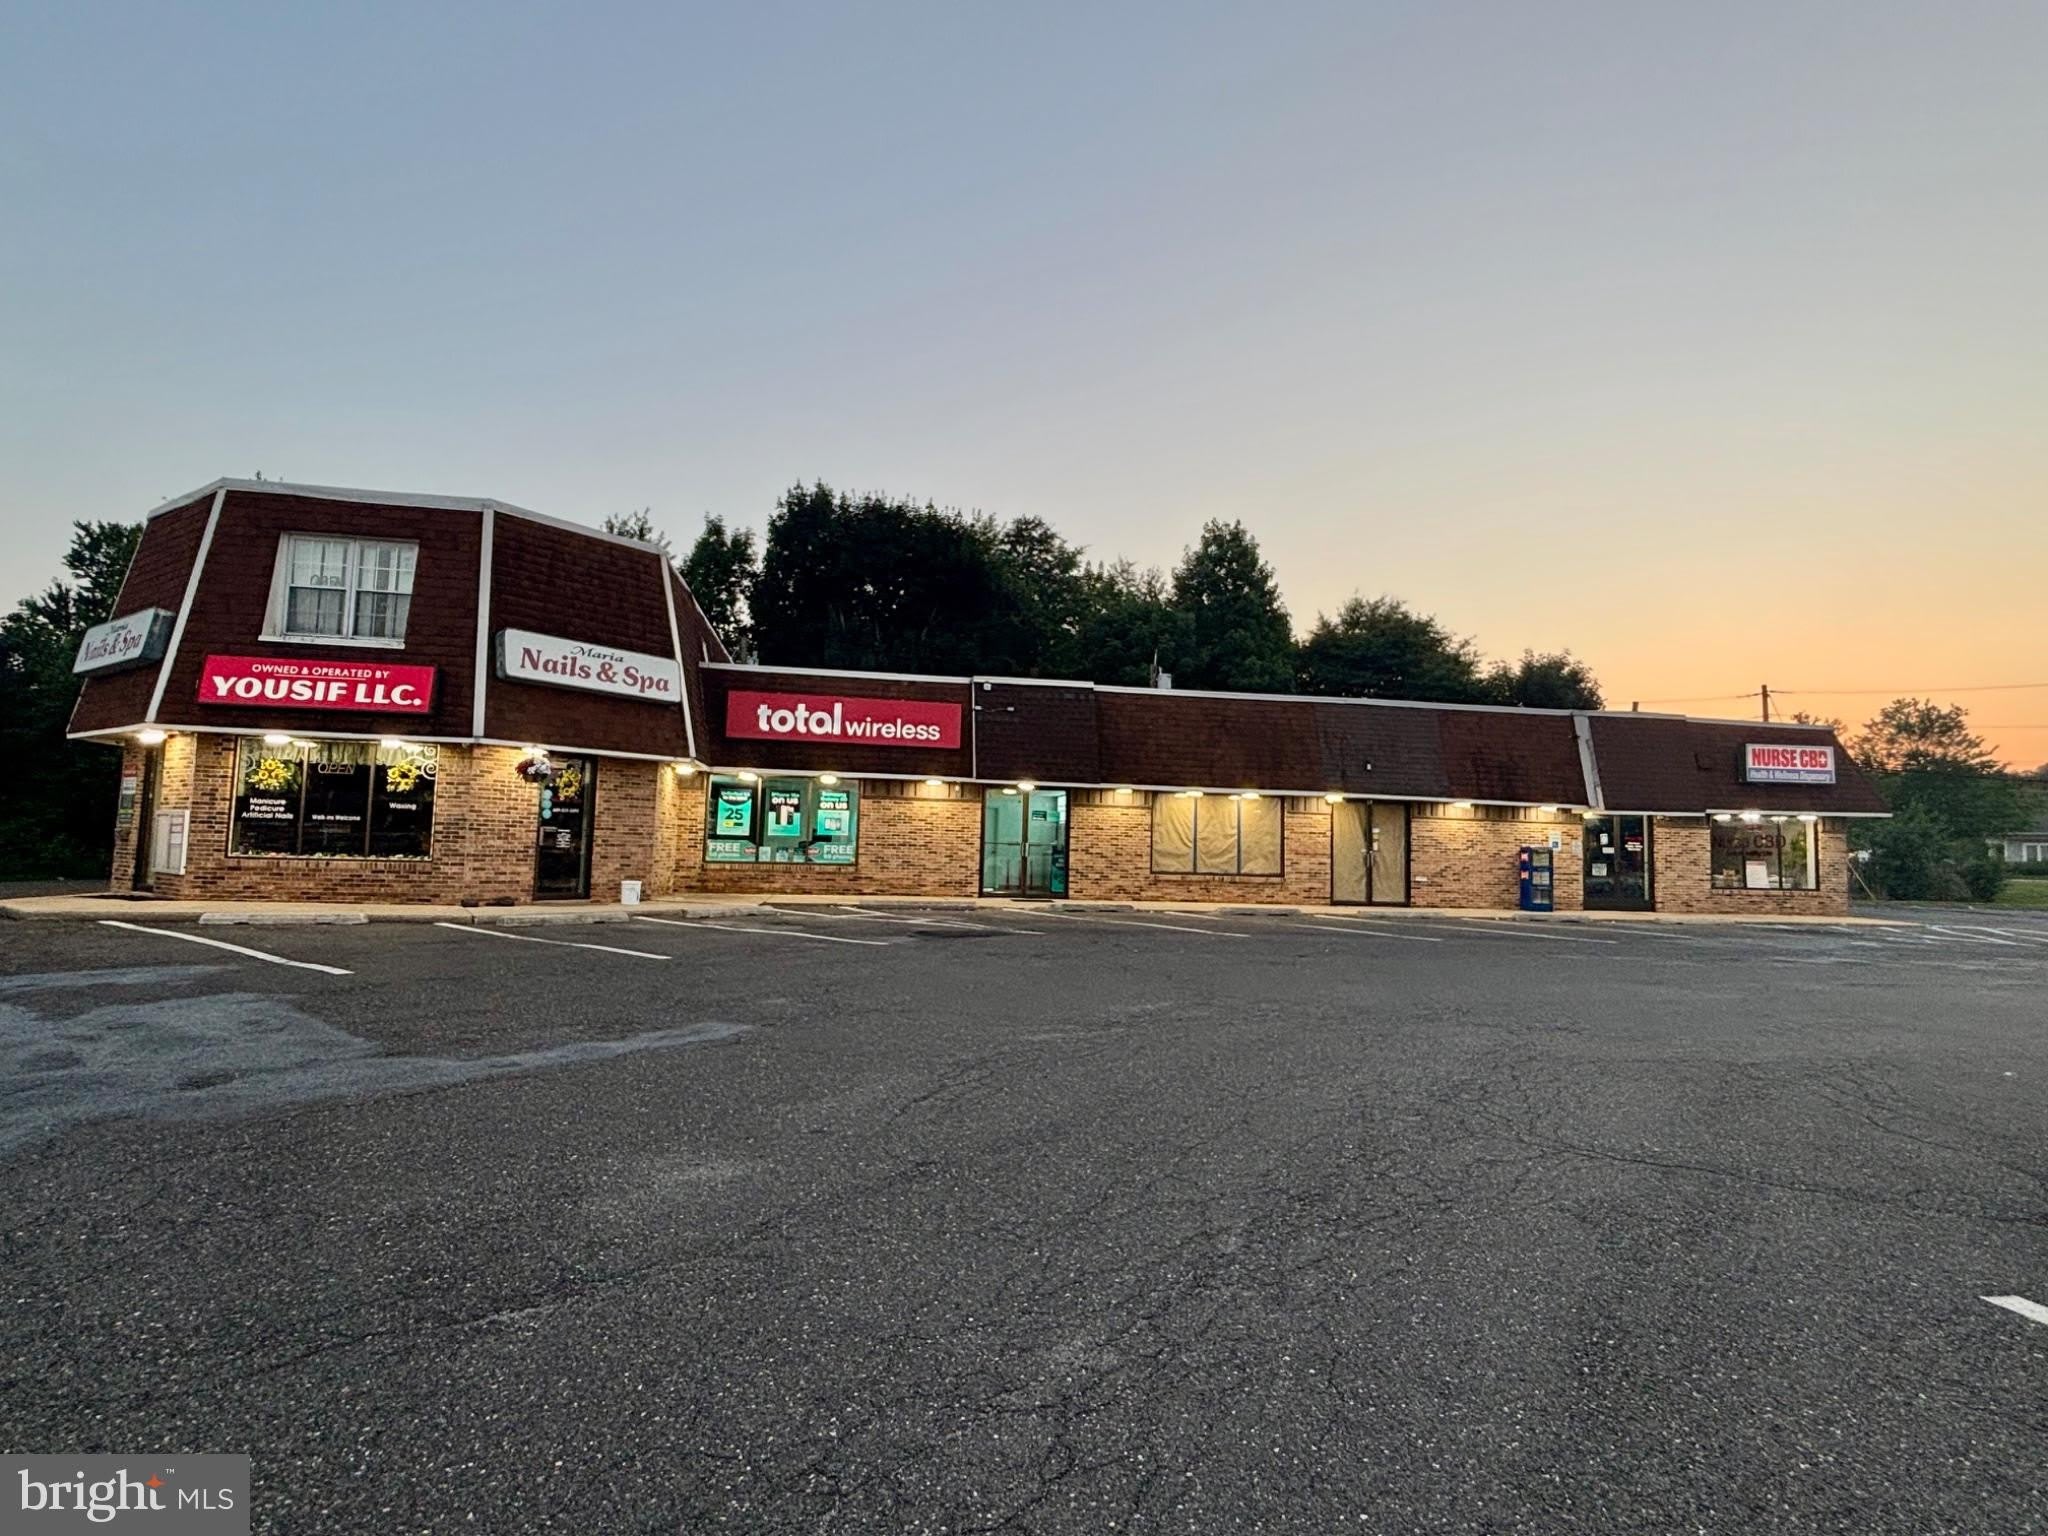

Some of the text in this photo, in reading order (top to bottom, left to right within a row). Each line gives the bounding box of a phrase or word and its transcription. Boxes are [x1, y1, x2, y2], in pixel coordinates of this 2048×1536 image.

[120, 630, 143, 656] Spa
[570, 646, 624, 663] Maria
[252, 664, 390, 679] OWNED & OPERATED BY
[520, 647, 670, 693] Nails & Spa
[212, 676, 422, 706] YOUSIF LLC.
[757, 702, 941, 741] total wireless
[1752, 748, 1828, 768] NURSE CBD
[318, 763, 356, 774] OPEN
[389, 802, 417, 811] Waxing
[771, 797, 799, 805] on us
[275, 812, 294, 820] Nails
[723, 808, 743, 820] 25
[709, 843, 741, 852] FREE
[824, 845, 853, 854] FREE
